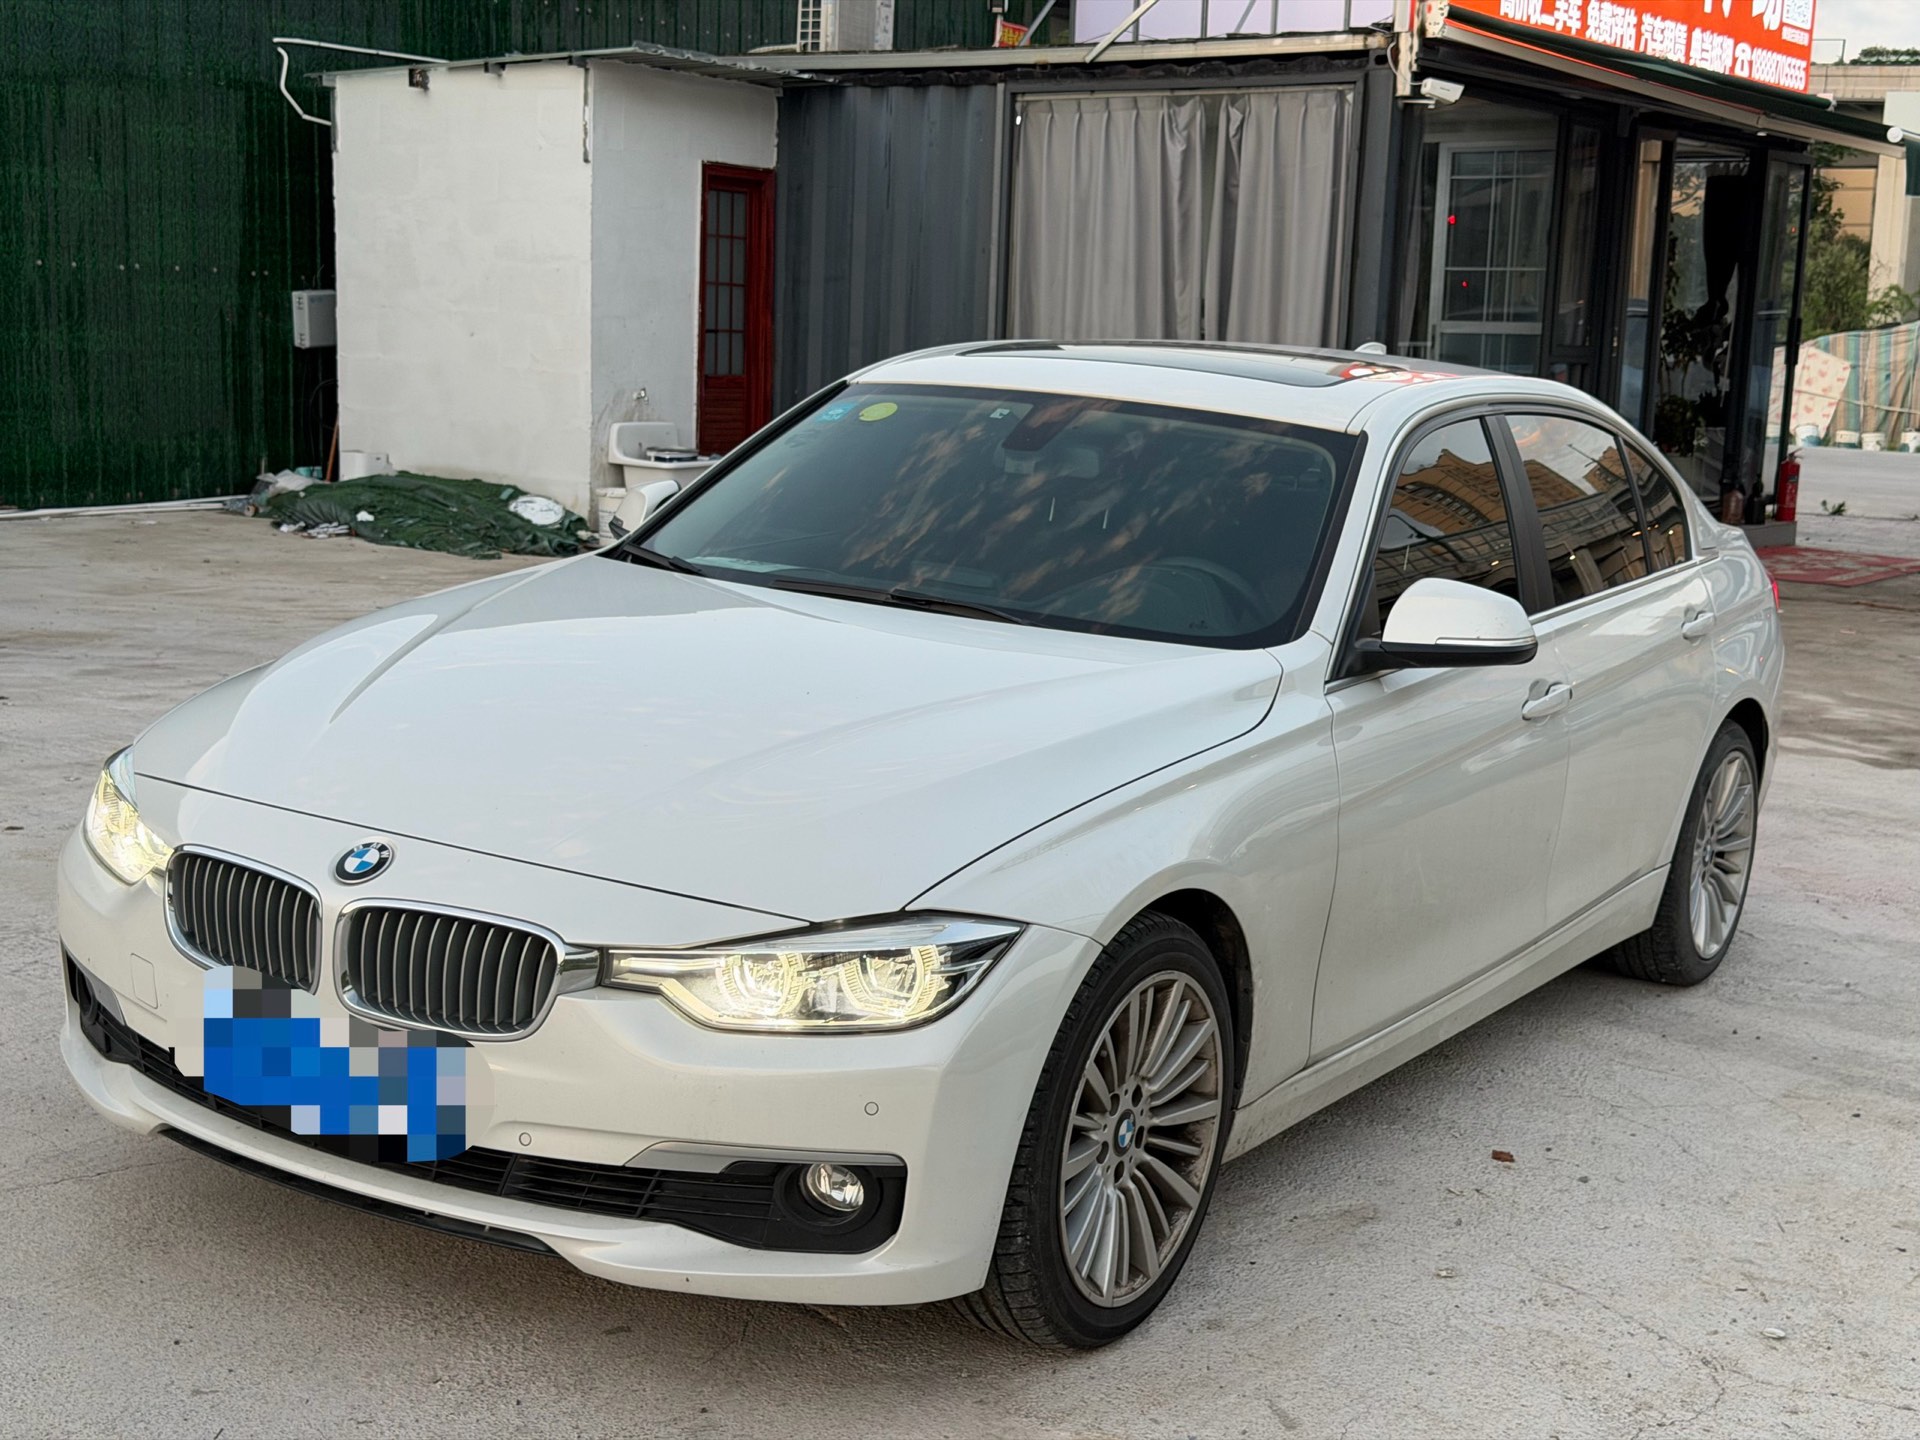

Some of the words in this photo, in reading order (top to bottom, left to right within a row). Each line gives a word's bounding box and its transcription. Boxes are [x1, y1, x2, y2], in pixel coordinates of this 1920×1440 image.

[1586, 0, 1637, 50] 免费评估
[1639, 12, 1688, 63] 汽车租赁
